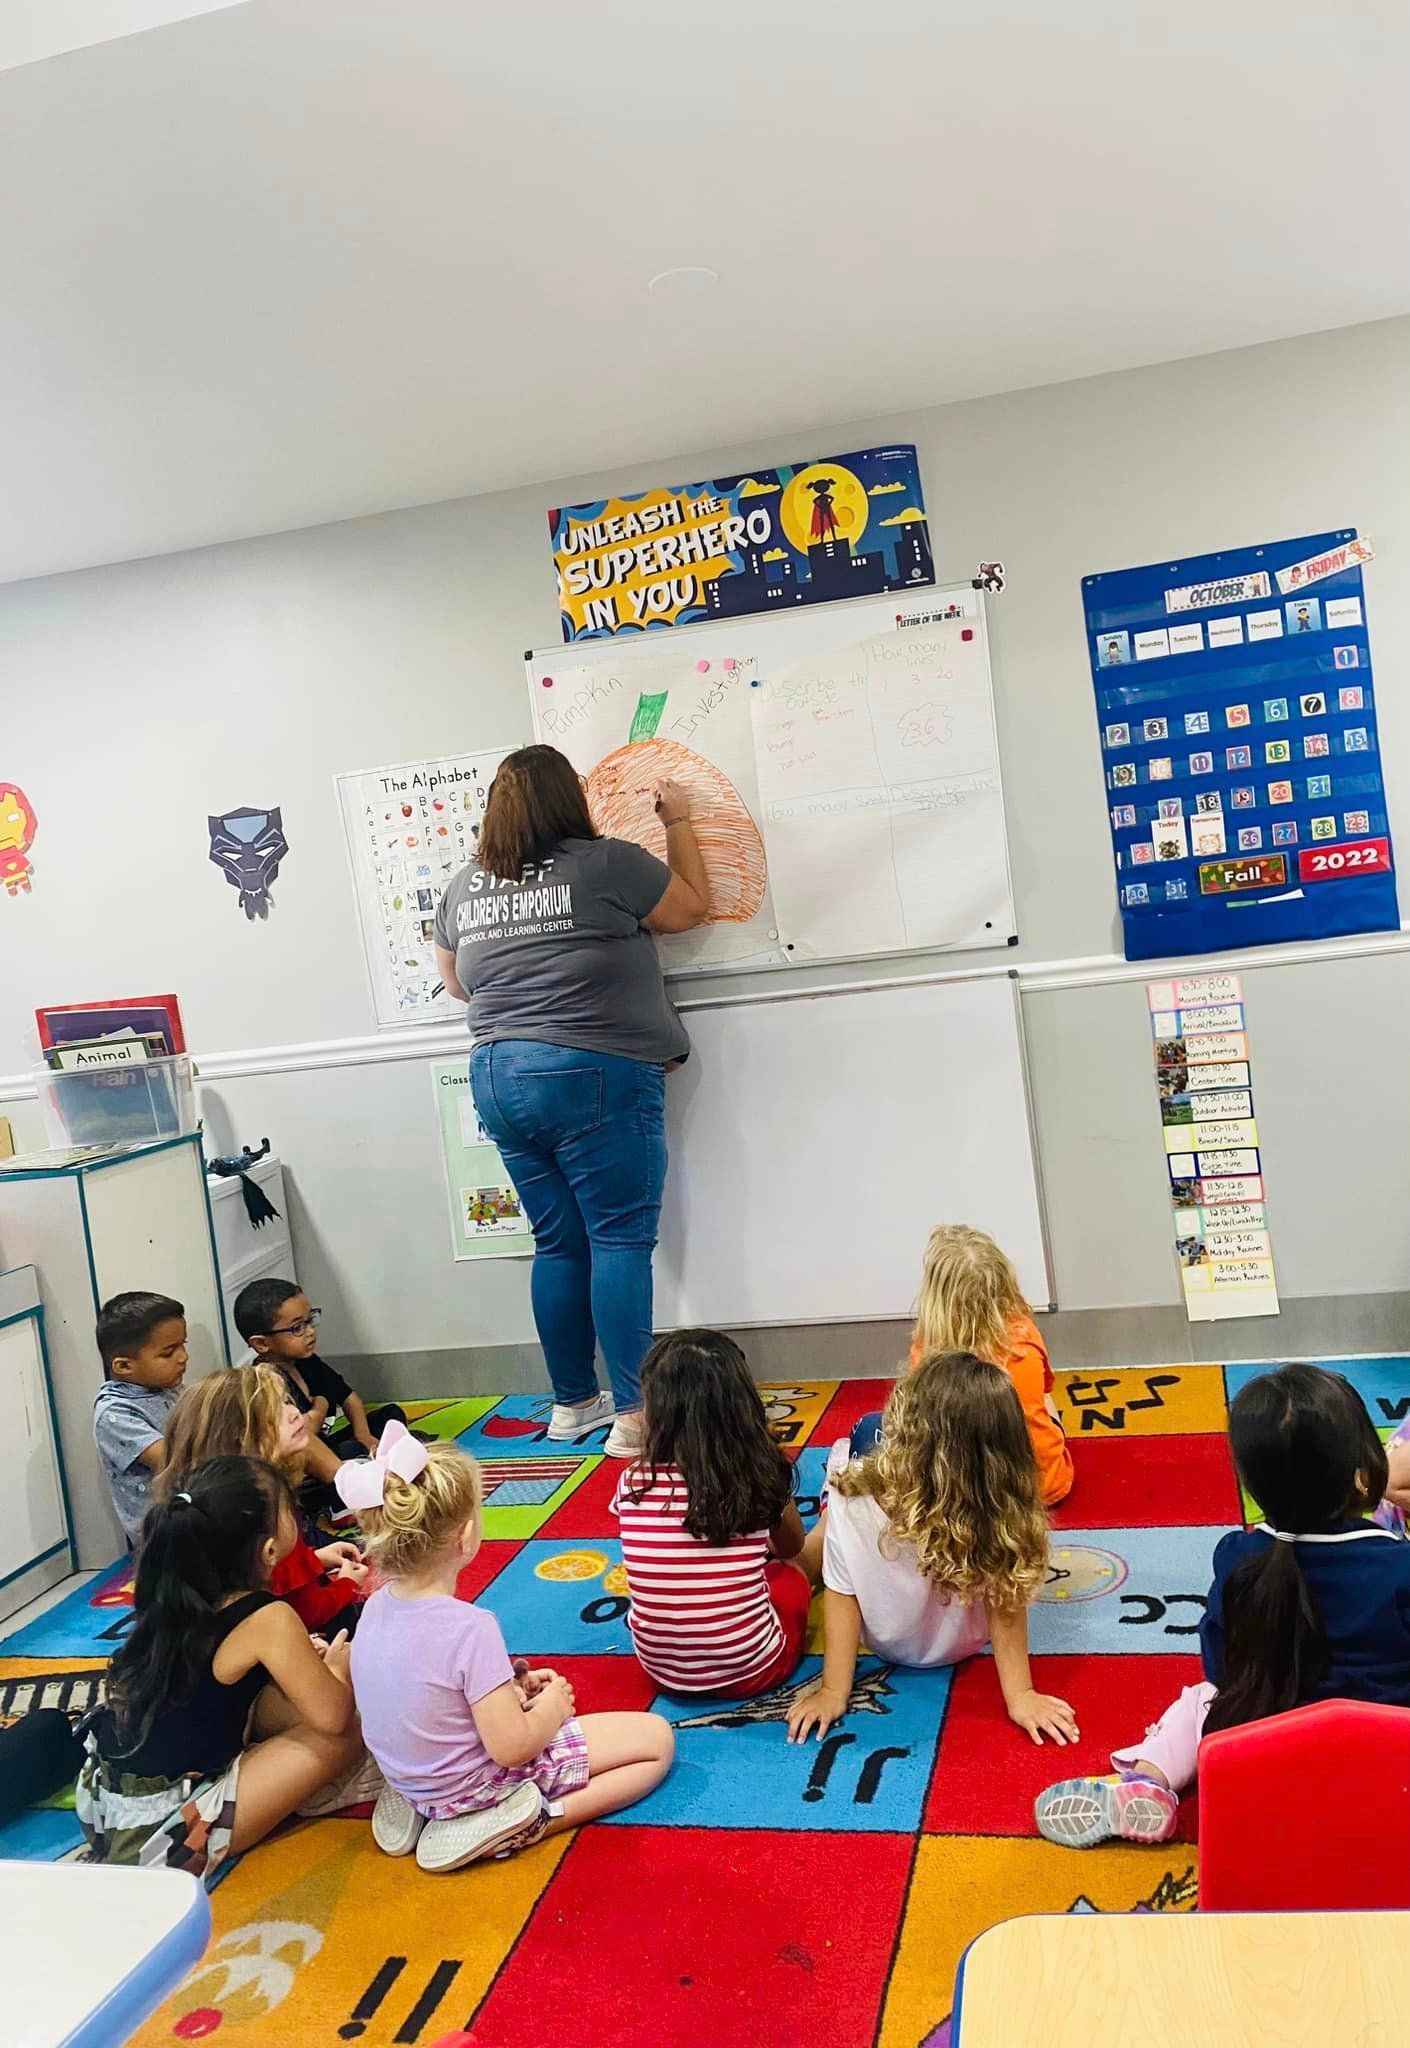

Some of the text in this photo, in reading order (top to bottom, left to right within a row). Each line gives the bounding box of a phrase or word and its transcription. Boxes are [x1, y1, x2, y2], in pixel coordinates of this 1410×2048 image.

[560, 497, 724, 555] UNLEASH THE
[564, 508, 771, 596] SUPERHERO
[1305, 551, 1348, 579] FRIDAY
[1190, 582, 1245, 605] OCTOBER
[583, 574, 697, 631] IN YOU
[922, 616, 930, 624] OF
[1103, 634, 1123, 642] Sunday
[1140, 640, 1164, 648] Monday
[1174, 634, 1198, 642] Tuesday
[1251, 621, 1278, 630] Thursday
[1342, 650, 1349, 666] 1
[1113, 690, 1356, 742] 2 3 4 5 6 7 8
[1120, 768, 1128, 782] 9
[1194, 758, 1207, 770] 11
[1231, 752, 1247, 766] 12
[1270, 746, 1286, 760] 13
[1309, 740, 1324, 754] 14
[1350, 734, 1363, 748] 15
[379, 767, 478, 793] The Alphabet
[419, 796, 427, 807] B
[449, 792, 457, 802] C
[476, 788, 486, 798] D
[1118, 781, 1327, 822] 16 17 18 19 20 21
[422, 808, 428, 818] b
[452, 806, 458, 814] c
[480, 800, 486, 809] d
[425, 826, 430, 836] F
[454, 822, 464, 832] G
[1158, 821, 1179, 829] Today
[458, 838, 464, 848] g
[1135, 847, 1152, 860] 23
[1243, 834, 1258, 844] 26
[1276, 827, 1293, 842] 27
[1315, 821, 1332, 836] 28
[1348, 814, 1365, 830] 29
[459, 853, 466, 862] J
[1311, 848, 1379, 872] 2022
[1224, 865, 1261, 884] Fall
[434, 888, 442, 897] N
[1130, 883, 1184, 899] 30 31
[456, 884, 572, 934] CHILDREN'S EMPORIUM
[488, 928, 503, 940] AND
[504, 923, 542, 938] LEARNING
[543, 919, 574, 932] CENTER
[422, 980, 429, 992] Z
[1182, 976, 1231, 992] 630-800
[1187, 1008, 1228, 1020] 800-830
[76, 1047, 132, 1066] Animal
[1190, 1064, 1232, 1075] 900-1030
[440, 1074, 472, 1086] Class
[1198, 1093, 1244, 1104] 1030-1100
[1200, 1122, 1240, 1134] 1100-1115
[1203, 1152, 1238, 1160] 1115-1130
[1207, 1182, 1244, 1191] 1130-1215
[1210, 1205, 1252, 1217] 1215-1230
[1213, 1234, 1254, 1245] 1230-300
[1218, 1263, 1258, 1274] 300-530
